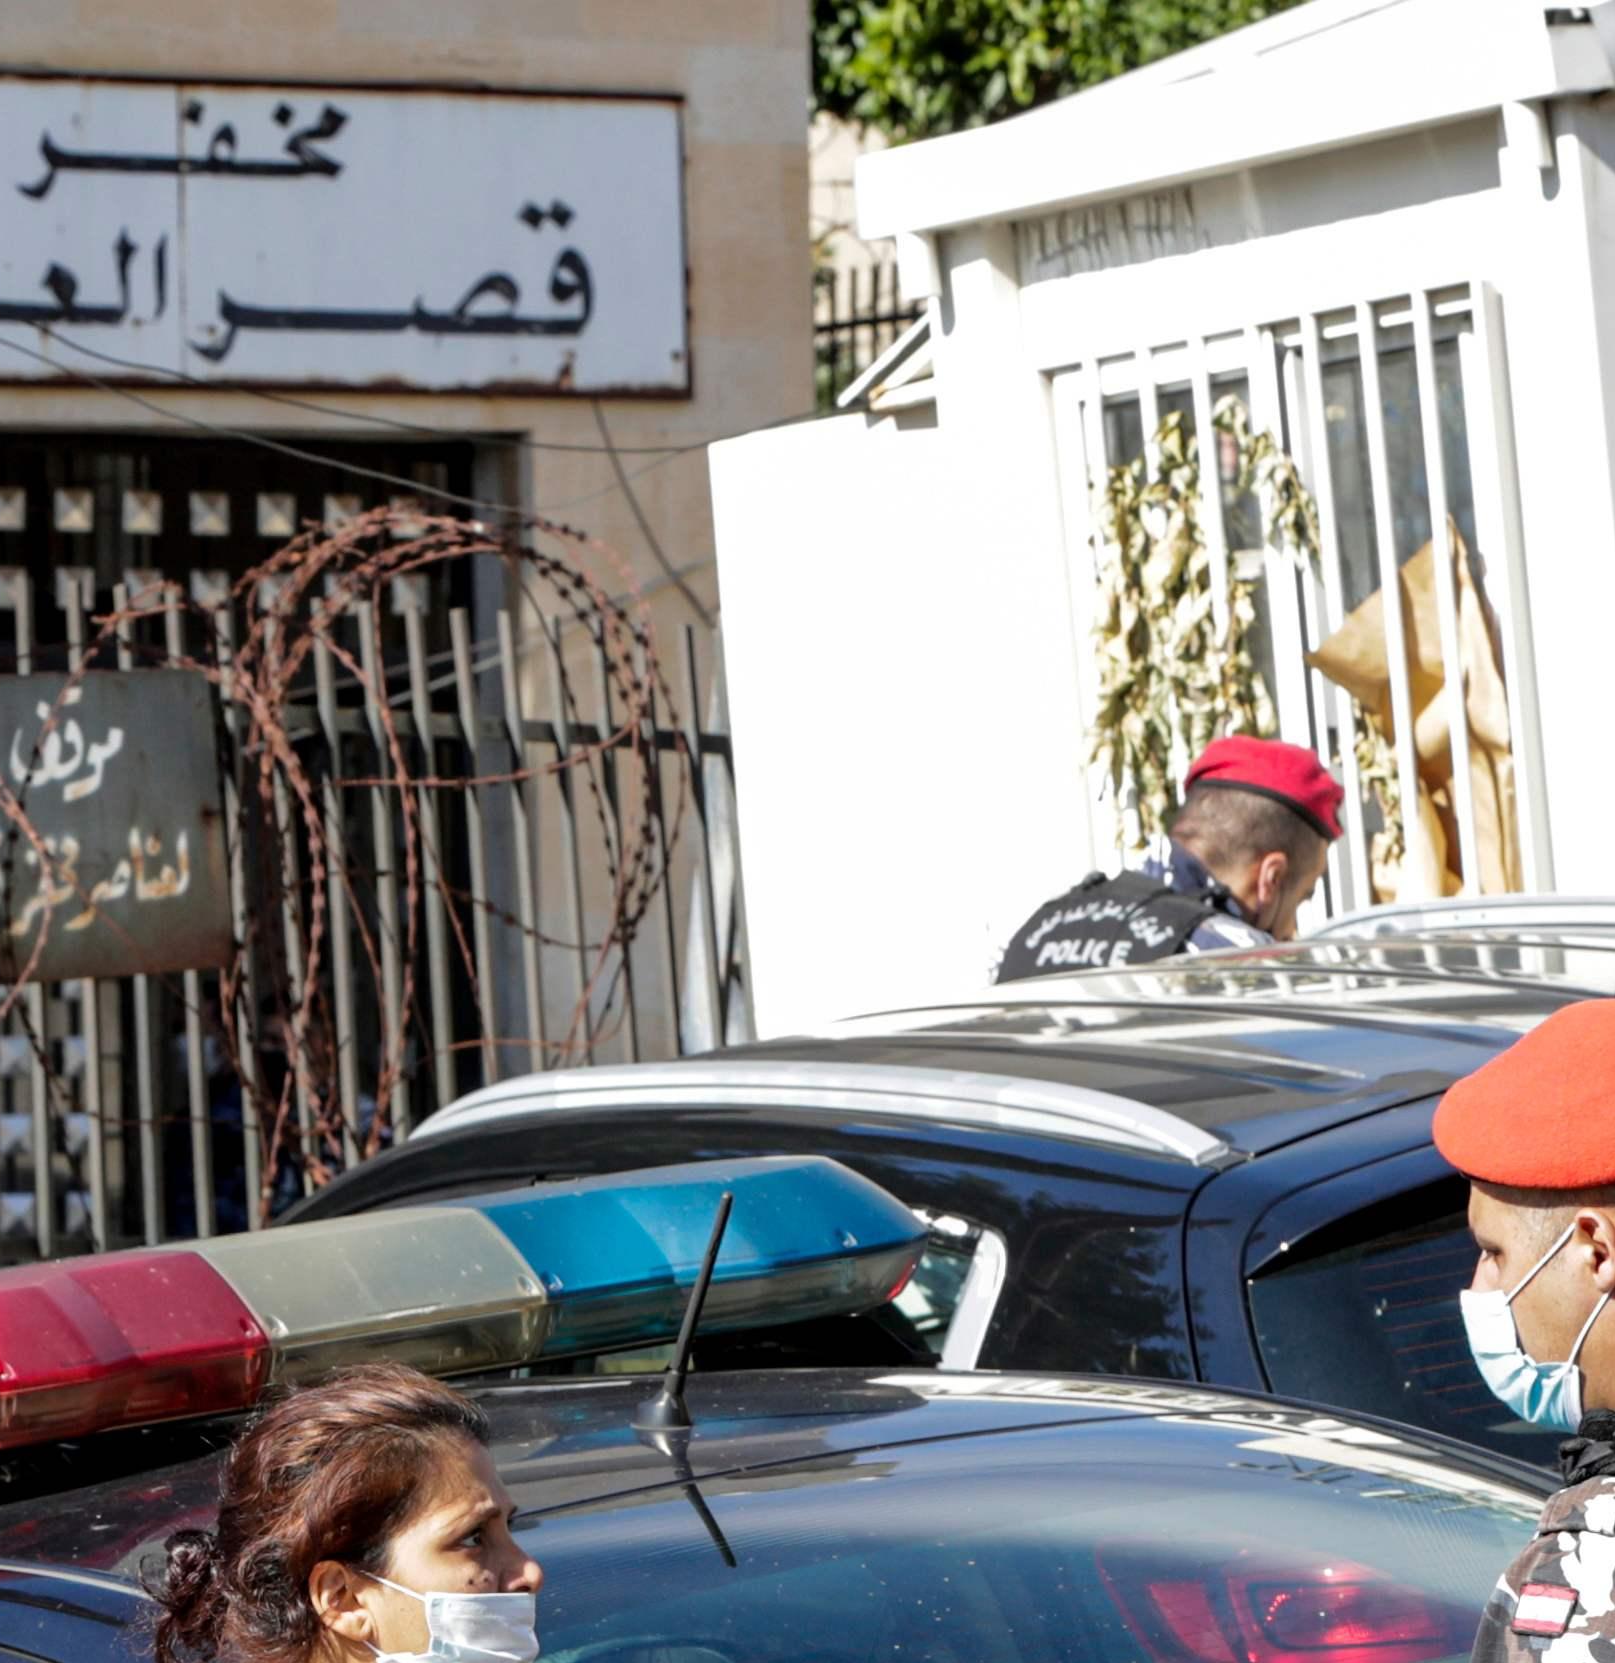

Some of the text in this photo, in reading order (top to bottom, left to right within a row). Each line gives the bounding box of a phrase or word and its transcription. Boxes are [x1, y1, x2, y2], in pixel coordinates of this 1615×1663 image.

[16, 102, 349, 199] مخفر
[185, 202, 595, 363] قصر
[8, 685, 126, 803] موقف
[1036, 938, 1133, 968] POLICE
